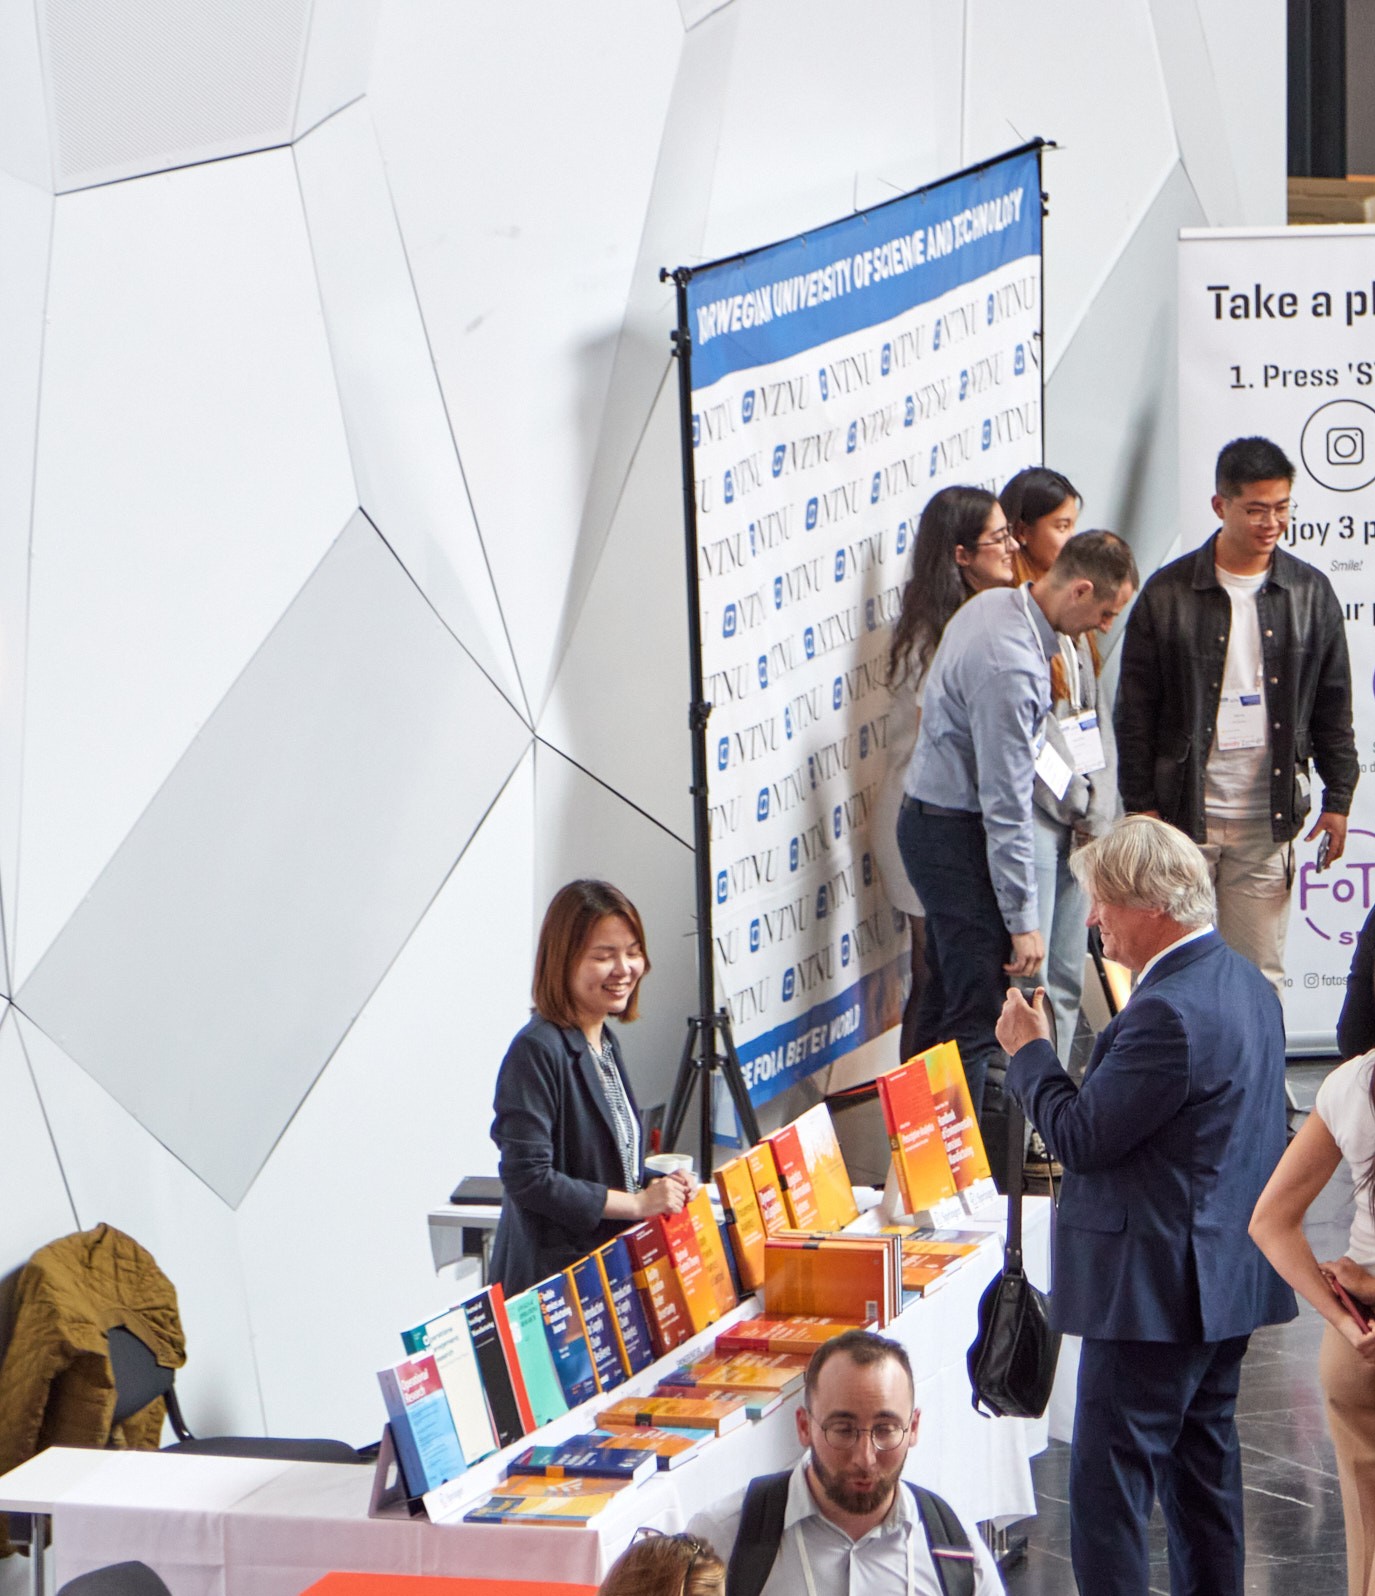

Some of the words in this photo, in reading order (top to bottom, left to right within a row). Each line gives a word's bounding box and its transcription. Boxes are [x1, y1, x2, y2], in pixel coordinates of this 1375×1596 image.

[853, 250, 873, 288] OF
[995, 276, 1037, 323] NTNU
[1206, 283, 1299, 320] Take
[1311, 290, 1332, 318] a
[1229, 365, 1254, 389] 1.
[1263, 364, 1340, 388] Press
[994, 401, 1037, 448] NTNU
[1338, 515, 1355, 540] 3
[1329, 559, 1364, 573] Smile!
